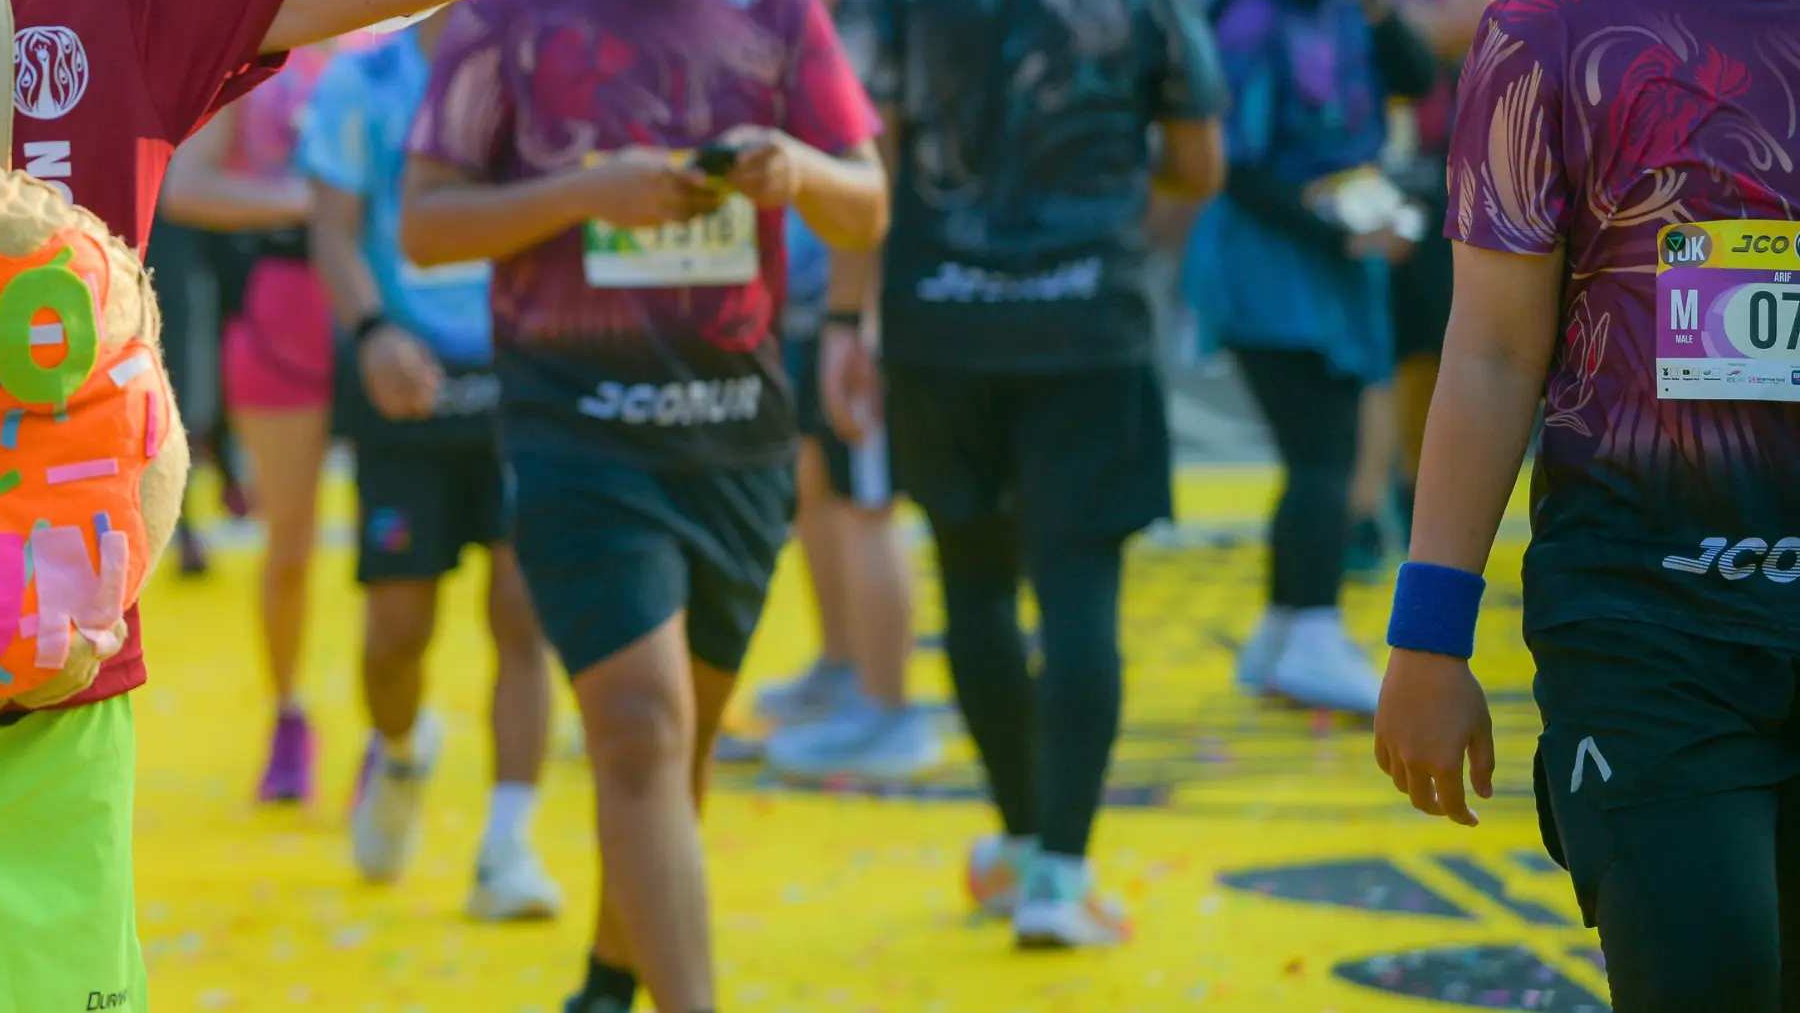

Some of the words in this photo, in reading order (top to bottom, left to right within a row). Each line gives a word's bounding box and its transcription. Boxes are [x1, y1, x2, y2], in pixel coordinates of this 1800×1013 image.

[1730, 234, 1790, 254] JCO
[1773, 271, 1792, 283] ARIF
[1670, 289, 1698, 330] M
[1749, 290, 1800, 350] 07
[1675, 334, 1693, 344] MALE
[1661, 536, 1800, 584] JCO
